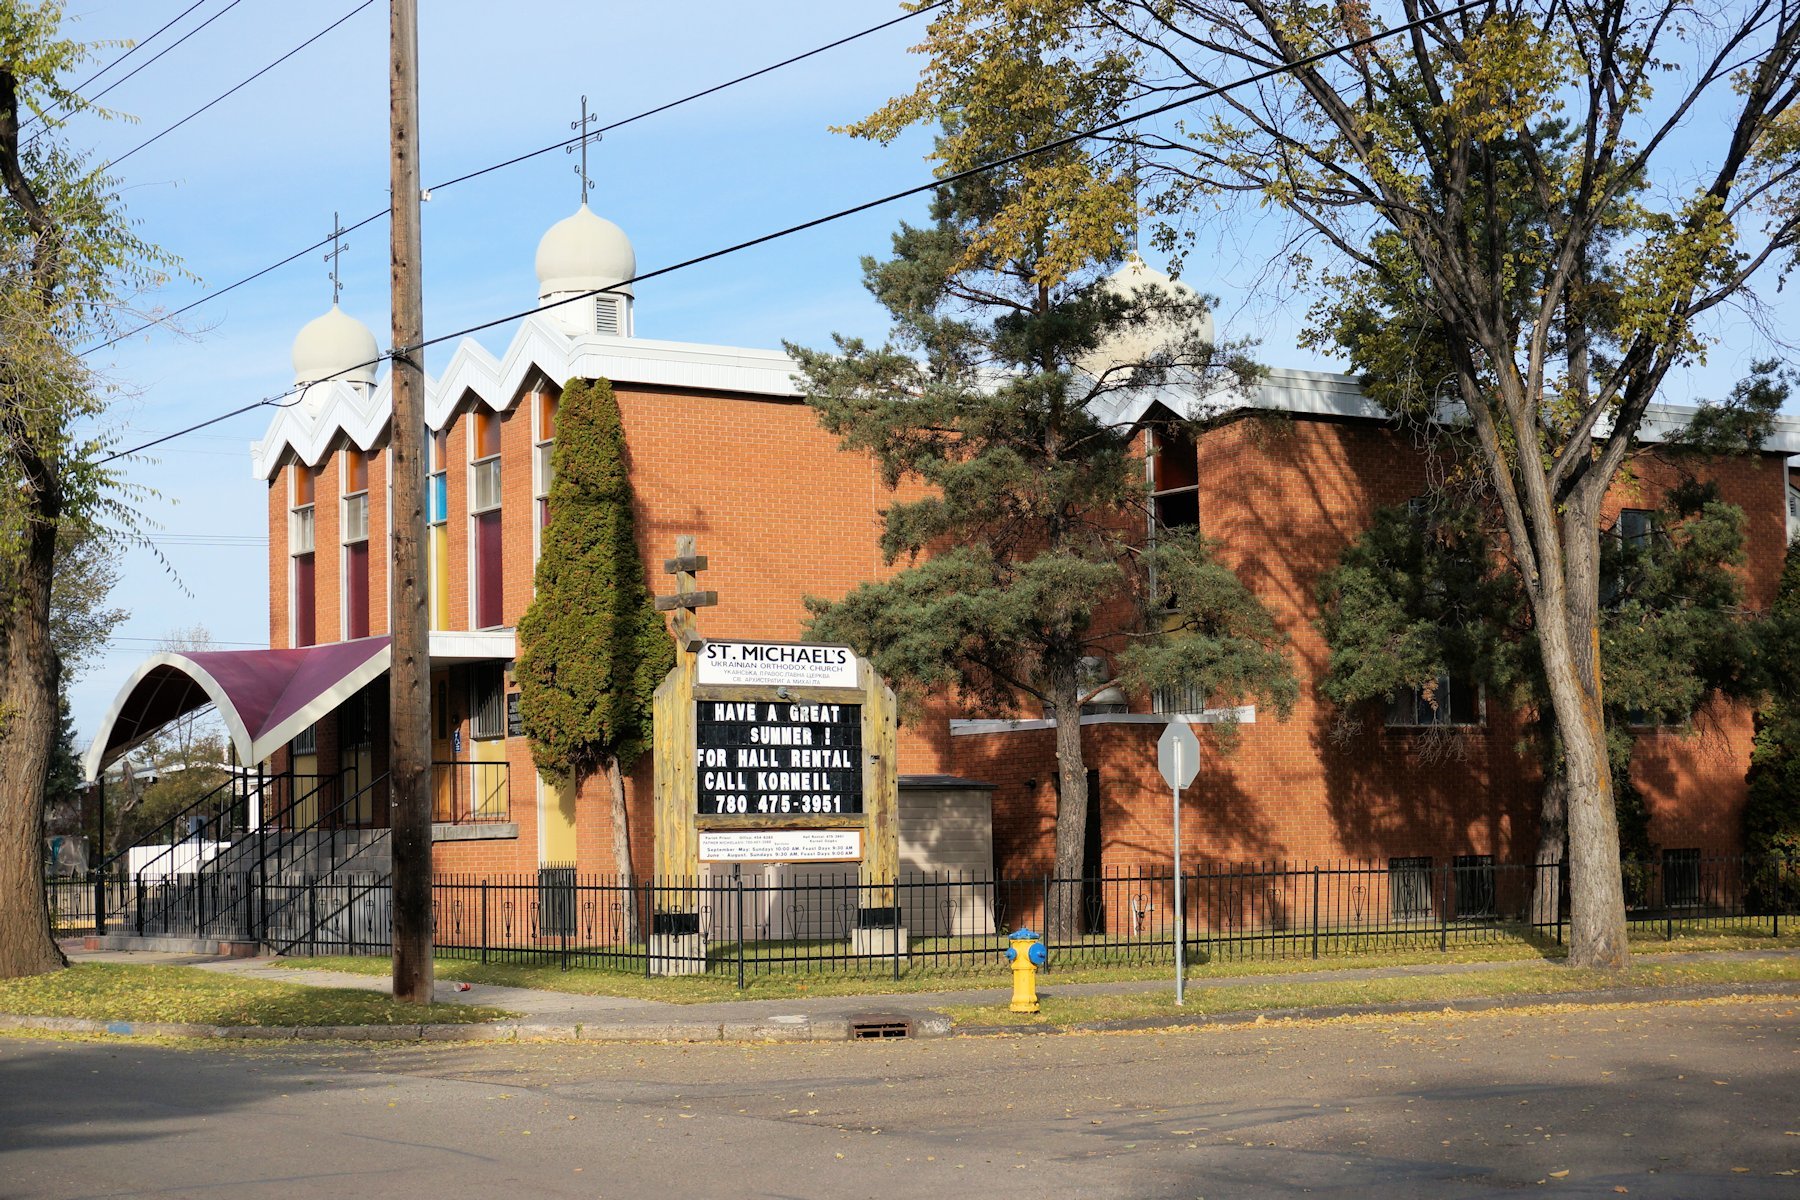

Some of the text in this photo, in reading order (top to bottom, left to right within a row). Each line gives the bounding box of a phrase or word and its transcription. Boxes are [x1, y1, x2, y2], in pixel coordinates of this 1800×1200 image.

[707, 644, 846, 664] ST. MICHAEL'S
[711, 661, 843, 673] UKRAINIAN ORTHODOX CHURCH
[715, 703, 839, 723] HAVE A GREAT
[750, 726, 812, 745] SUMMER
[698, 749, 851, 768] FOR HALL RENTAL
[705, 772, 831, 790] CALL KORNEIL
[716, 795, 841, 813] 780 475-3951
